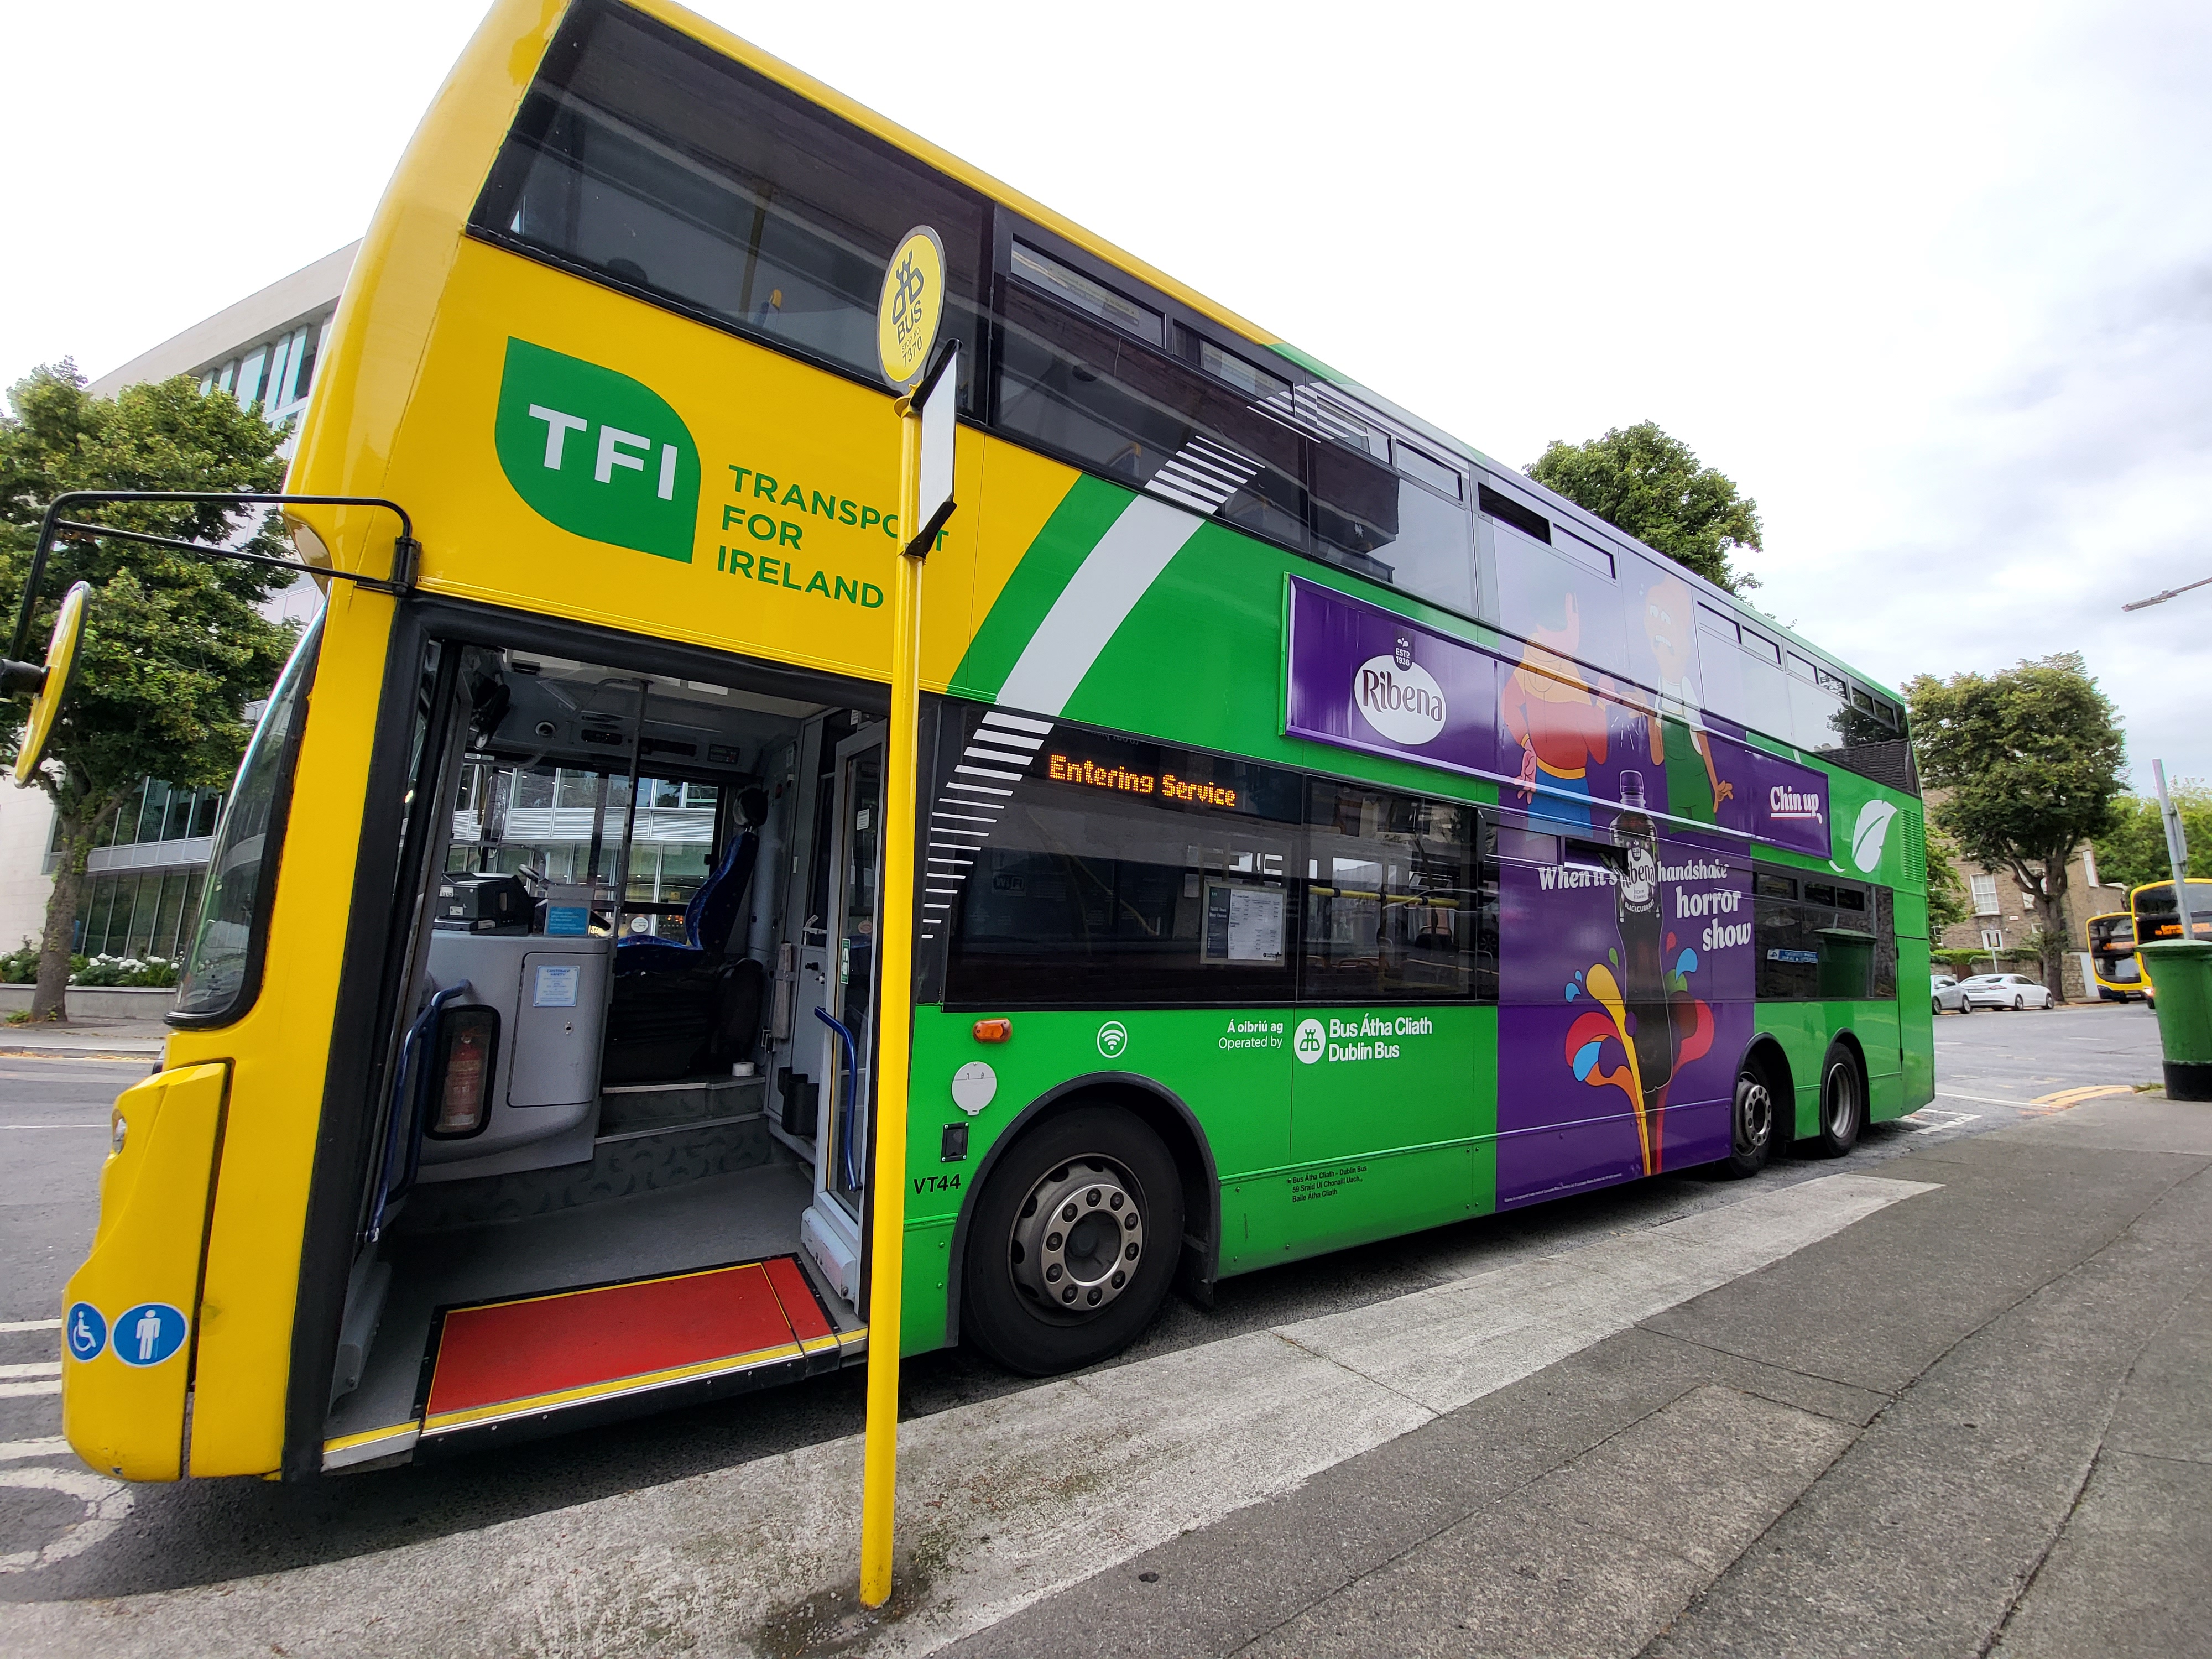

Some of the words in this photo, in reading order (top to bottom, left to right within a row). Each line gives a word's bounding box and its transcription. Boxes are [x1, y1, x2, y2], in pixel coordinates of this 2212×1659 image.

[897, 300, 922, 345] BUS
[901, 336, 912, 353] STOP
[902, 336, 922, 368] 7370
[528, 403, 678, 502] TFI
[728, 464, 950, 552] TRANSPOT
[722, 504, 802, 550] FOR
[718, 545, 885, 609] IRELAND
[1395, 656, 1410, 666] 1938
[1362, 669, 1443, 722] Ribena
[1050, 754, 1154, 794] Entering
[1161, 774, 1237, 807] Service
[1770, 785, 1802, 811] Chin
[1802, 793, 1819, 817] up
[1537, 866, 1591, 890] When
[1657, 858, 1728, 883] handshake
[1676, 886, 1742, 919] horror
[1702, 918, 1751, 951] show
[1227, 1019, 1235, 1033] Á
[1237, 1020, 1268, 1032] oibriú
[1270, 1022, 1283, 1034] ag
[1329, 1019, 1358, 1038] Bus
[1359, 1013, 1393, 1037] Átha
[1395, 1017, 1433, 1035] Cliath
[1218, 1036, 1267, 1051] Operated
[1270, 1036, 1283, 1048] by
[1328, 1044, 1373, 1062] Dublin
[1374, 1042, 1400, 1059] Bus
[913, 1173, 961, 1194] VT44
[1305, 1173, 1318, 1182] Átha
[1319, 1171, 1335, 1179] Cliath
[1339, 1167, 1356, 1176] Dublin
[1323, 1178, 1345, 1187] Chonaill
[1308, 1191, 1321, 1201] Átha
[1322, 1188, 1338, 1197] Cliath
